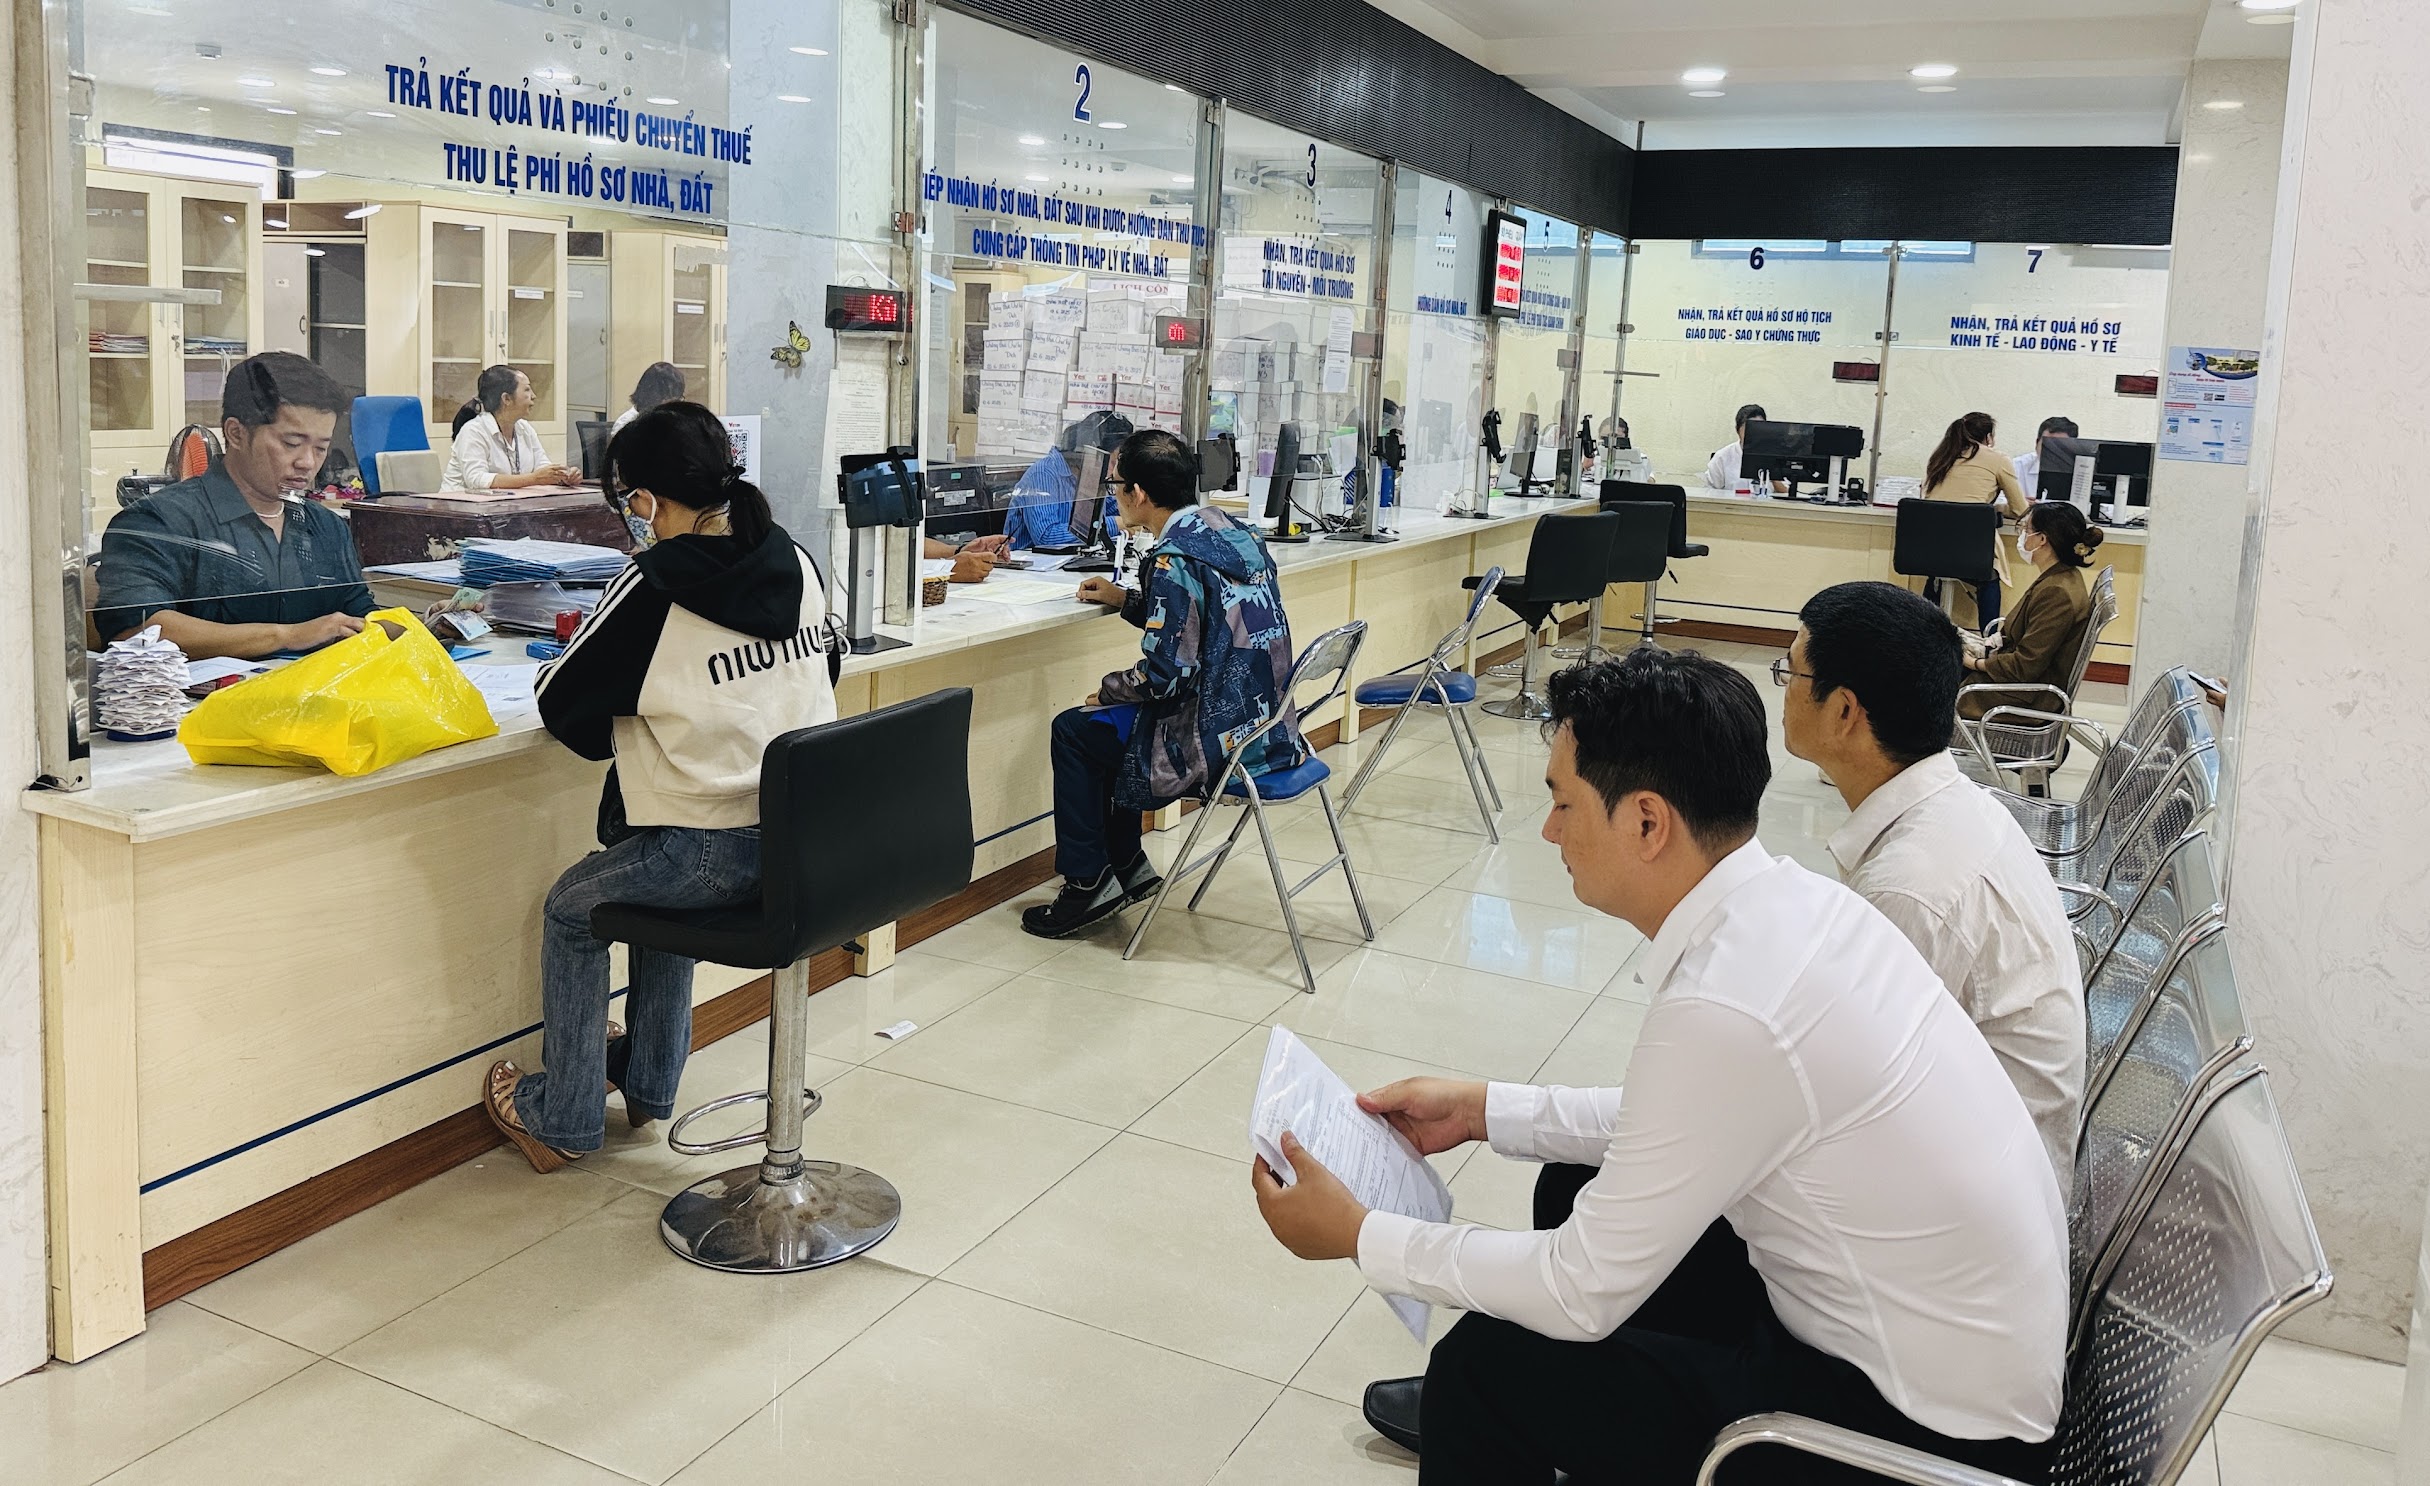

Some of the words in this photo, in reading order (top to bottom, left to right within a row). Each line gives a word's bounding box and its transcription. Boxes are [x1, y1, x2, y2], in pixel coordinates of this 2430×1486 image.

[1074, 63, 1091, 123] 2
[385, 56, 432, 110] TRẢ
[440, 67, 482, 118] KẾT
[489, 77, 533, 126] QUẢ
[539, 88, 565, 132] VÀ
[572, 96, 630, 143] PHIẾU
[635, 109, 706, 157] CHUYỂN
[711, 124, 754, 166] THUẾ
[443, 142, 487, 185] THU
[494, 145, 518, 196] LỆ
[526, 152, 561, 194] PHÍ
[567, 152, 594, 199] HỒ
[600, 166, 626, 202] SƠ
[631, 168, 675, 214] NHÀ,
[679, 170, 713, 215] ĐẤT
[1306, 143, 1317, 187] 3
[922, 166, 944, 201] IẾP
[947, 175, 980, 213] NHẬN
[982, 177, 997, 212] HỒ
[1000, 187, 1015, 215] SƠ
[1017, 188, 1041, 223] NHÀ,
[1043, 190, 1063, 223] ĐẤT
[1065, 202, 1082, 226] SAU
[1085, 205, 1100, 230] KHI
[1102, 208, 1126, 237] ĐƯỢC
[1128, 210, 1156, 239] HƯỚNG
[1158, 211, 1174, 242] DẪN
[1176, 217, 1190, 245] THỦ
[1192, 225, 1205, 250] TỤC
[1445, 190, 1453, 224] 4
[973, 228, 1004, 257] CUNG
[1006, 226, 1027, 260] CẤP
[1030, 235, 1063, 265] THÔNG
[1065, 242, 1080, 267] TIN
[1082, 240, 1106, 270] PHÁP
[1108, 244, 1119, 272] LÝ
[1120, 244, 1131, 273] VỀ
[1133, 251, 1152, 279] NHÀ,
[1153, 249, 1169, 278] ĐẤT
[1544, 221, 1550, 252] 5
[1263, 238, 1287, 266] NHẬN,
[1289, 241, 1303, 266] TRẢ
[1305, 243, 1319, 269] KẾT
[1320, 247, 1334, 272] QUẢ
[1335, 249, 1345, 273] HỒ
[1345, 255, 1356, 275] SƠ
[1750, 247, 1765, 270] 6
[2027, 249, 2043, 274] 7
[1262, 265, 1274, 289] TÀI
[1275, 270, 1306, 293] NGUYÊN
[1312, 275, 1326, 296] MÔI
[1328, 275, 1354, 299] TRƯỜNG
[1678, 307, 1705, 323] NHẬN,
[1708, 306, 1724, 321] TRẢ
[1726, 306, 1743, 321] KẾT
[1746, 307, 1764, 323] QUẢ
[1766, 307, 1779, 322] HỒ
[1781, 310, 1794, 322] SƠ
[1796, 309, 1808, 325] HỘ
[1811, 311, 1832, 326] TỊCH
[1950, 314, 1990, 332] NHẬN,
[1995, 314, 2018, 331] TRẢ
[2022, 315, 2047, 332] KẾT
[2050, 317, 2076, 334] QUẢ
[2080, 318, 2099, 335] HỒ
[2102, 322, 2121, 336] SƠ
[1685, 326, 1706, 340] GIÁO
[1708, 329, 1726, 342] DỤC
[1735, 329, 1752, 341] SAO
[1755, 330, 1761, 341] Y
[1763, 328, 1794, 342] CHỨNG
[1797, 330, 1821, 345] THỰC
[1950, 333, 1981, 347] KINH
[1985, 332, 2001, 348] TẾ
[2012, 336, 2036, 350] LAO
[2040, 336, 2077, 352] ĐỘNG
[2091, 340, 2098, 353] Y
[2102, 337, 2118, 353] TẾ
[1073, 373, 1086, 381] Yes
[1121, 373, 1132, 381] Yes
